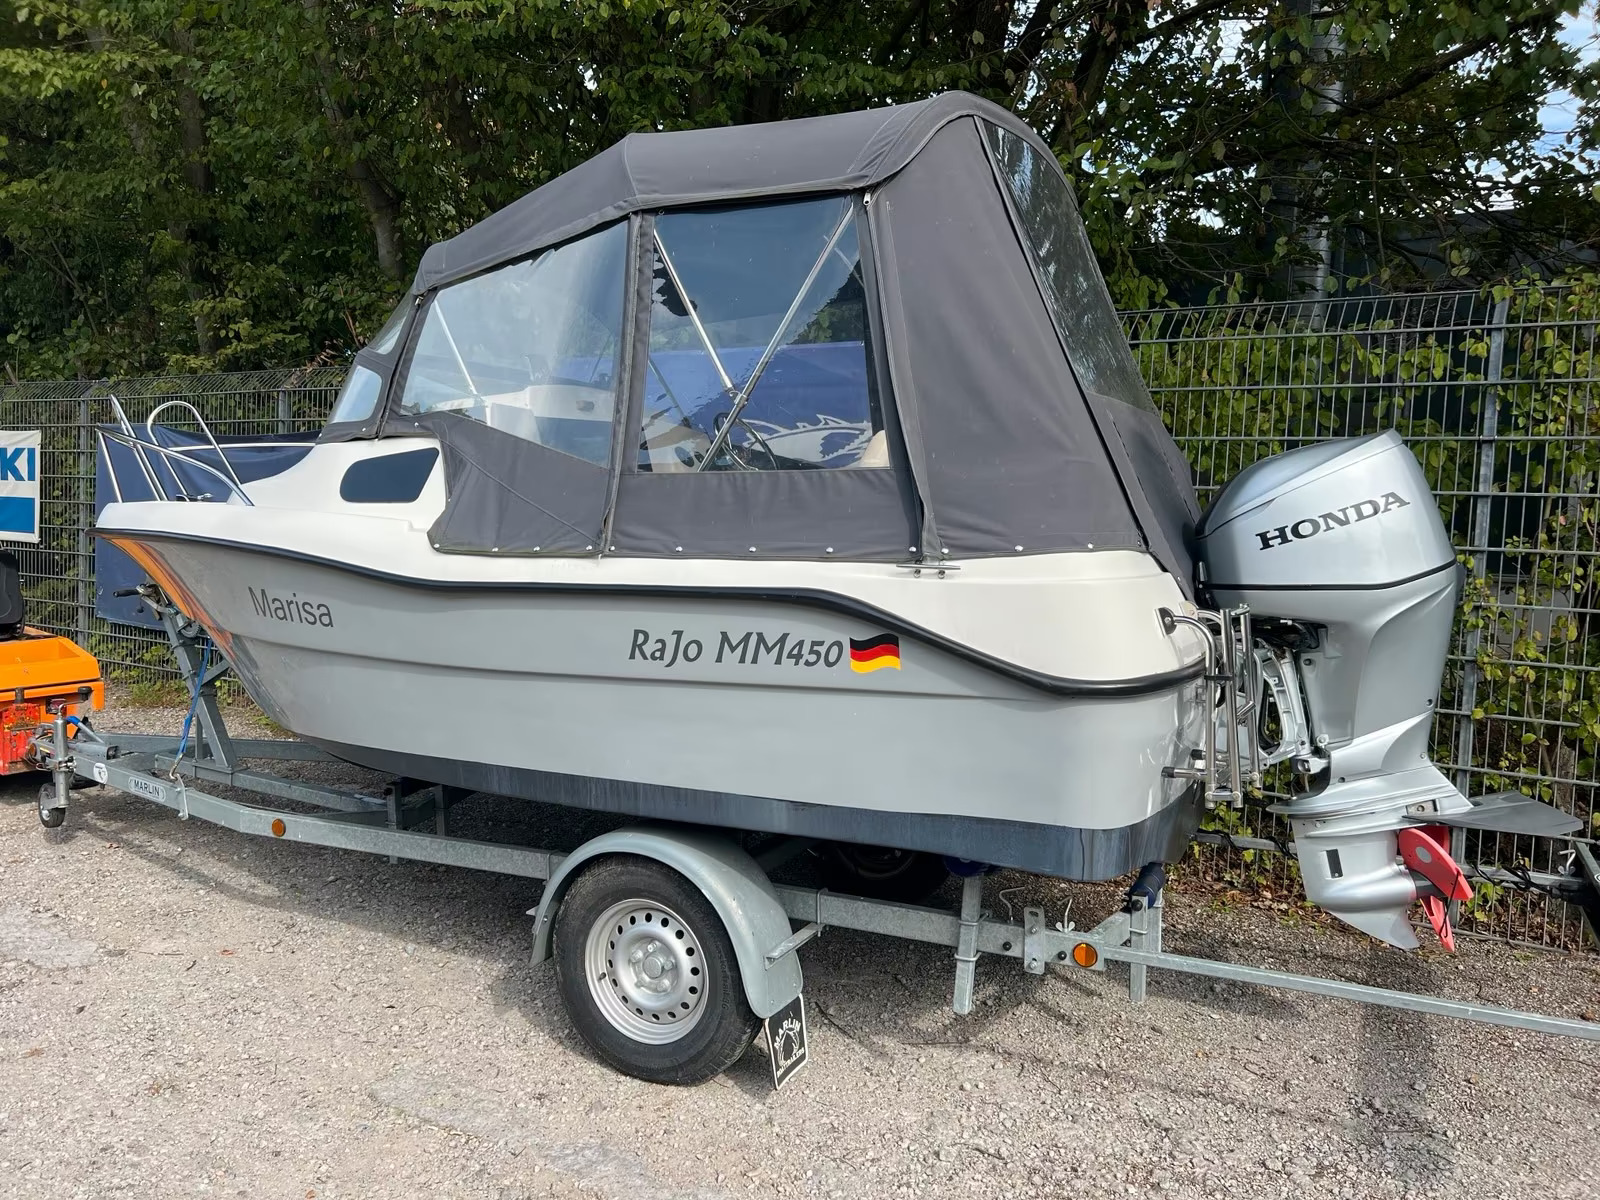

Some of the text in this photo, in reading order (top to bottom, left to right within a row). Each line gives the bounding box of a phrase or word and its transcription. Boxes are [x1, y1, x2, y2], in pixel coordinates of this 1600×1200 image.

[1255, 491, 1411, 550] HONDA
[247, 586, 334, 628] Marisa
[628, 629, 844, 668] RaJo MM450
[134, 779, 160, 797] MARLIN
[773, 1017, 802, 1050] MARLIN
